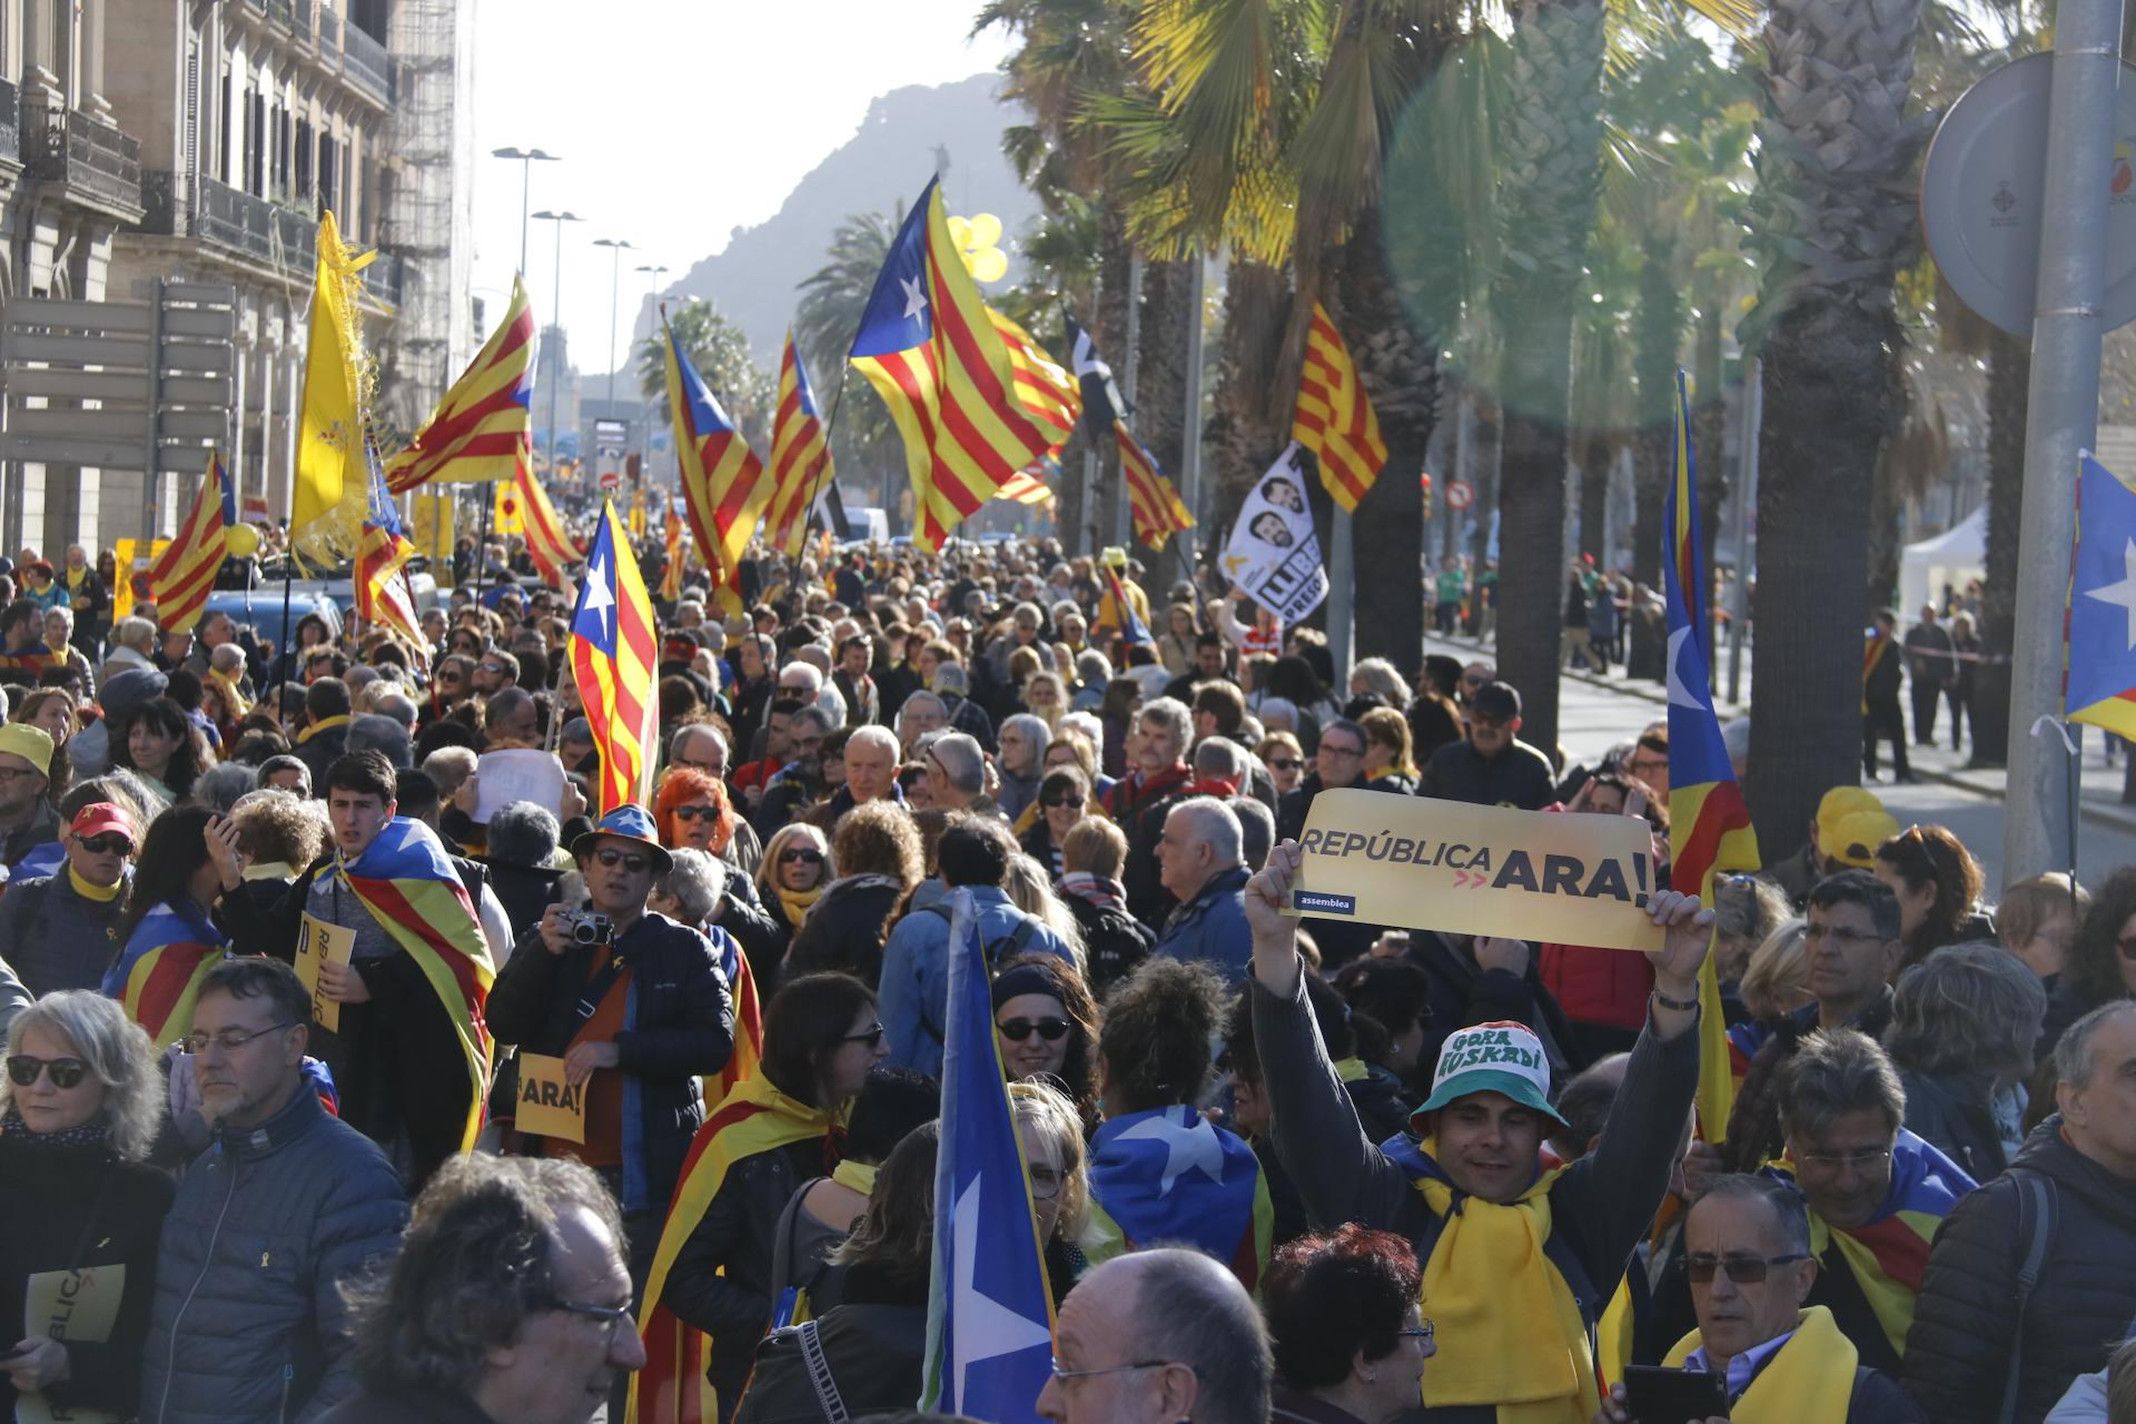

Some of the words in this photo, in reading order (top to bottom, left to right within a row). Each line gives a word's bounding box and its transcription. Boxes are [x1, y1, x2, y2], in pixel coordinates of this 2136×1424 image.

[1300, 828, 1491, 871] REPÚBLICA
[1491, 849, 1648, 908] ARA!
[1301, 896, 1350, 909] assemblea
[1453, 1030, 1512, 1051] GORA
[522, 1078, 581, 1116] ARA!
